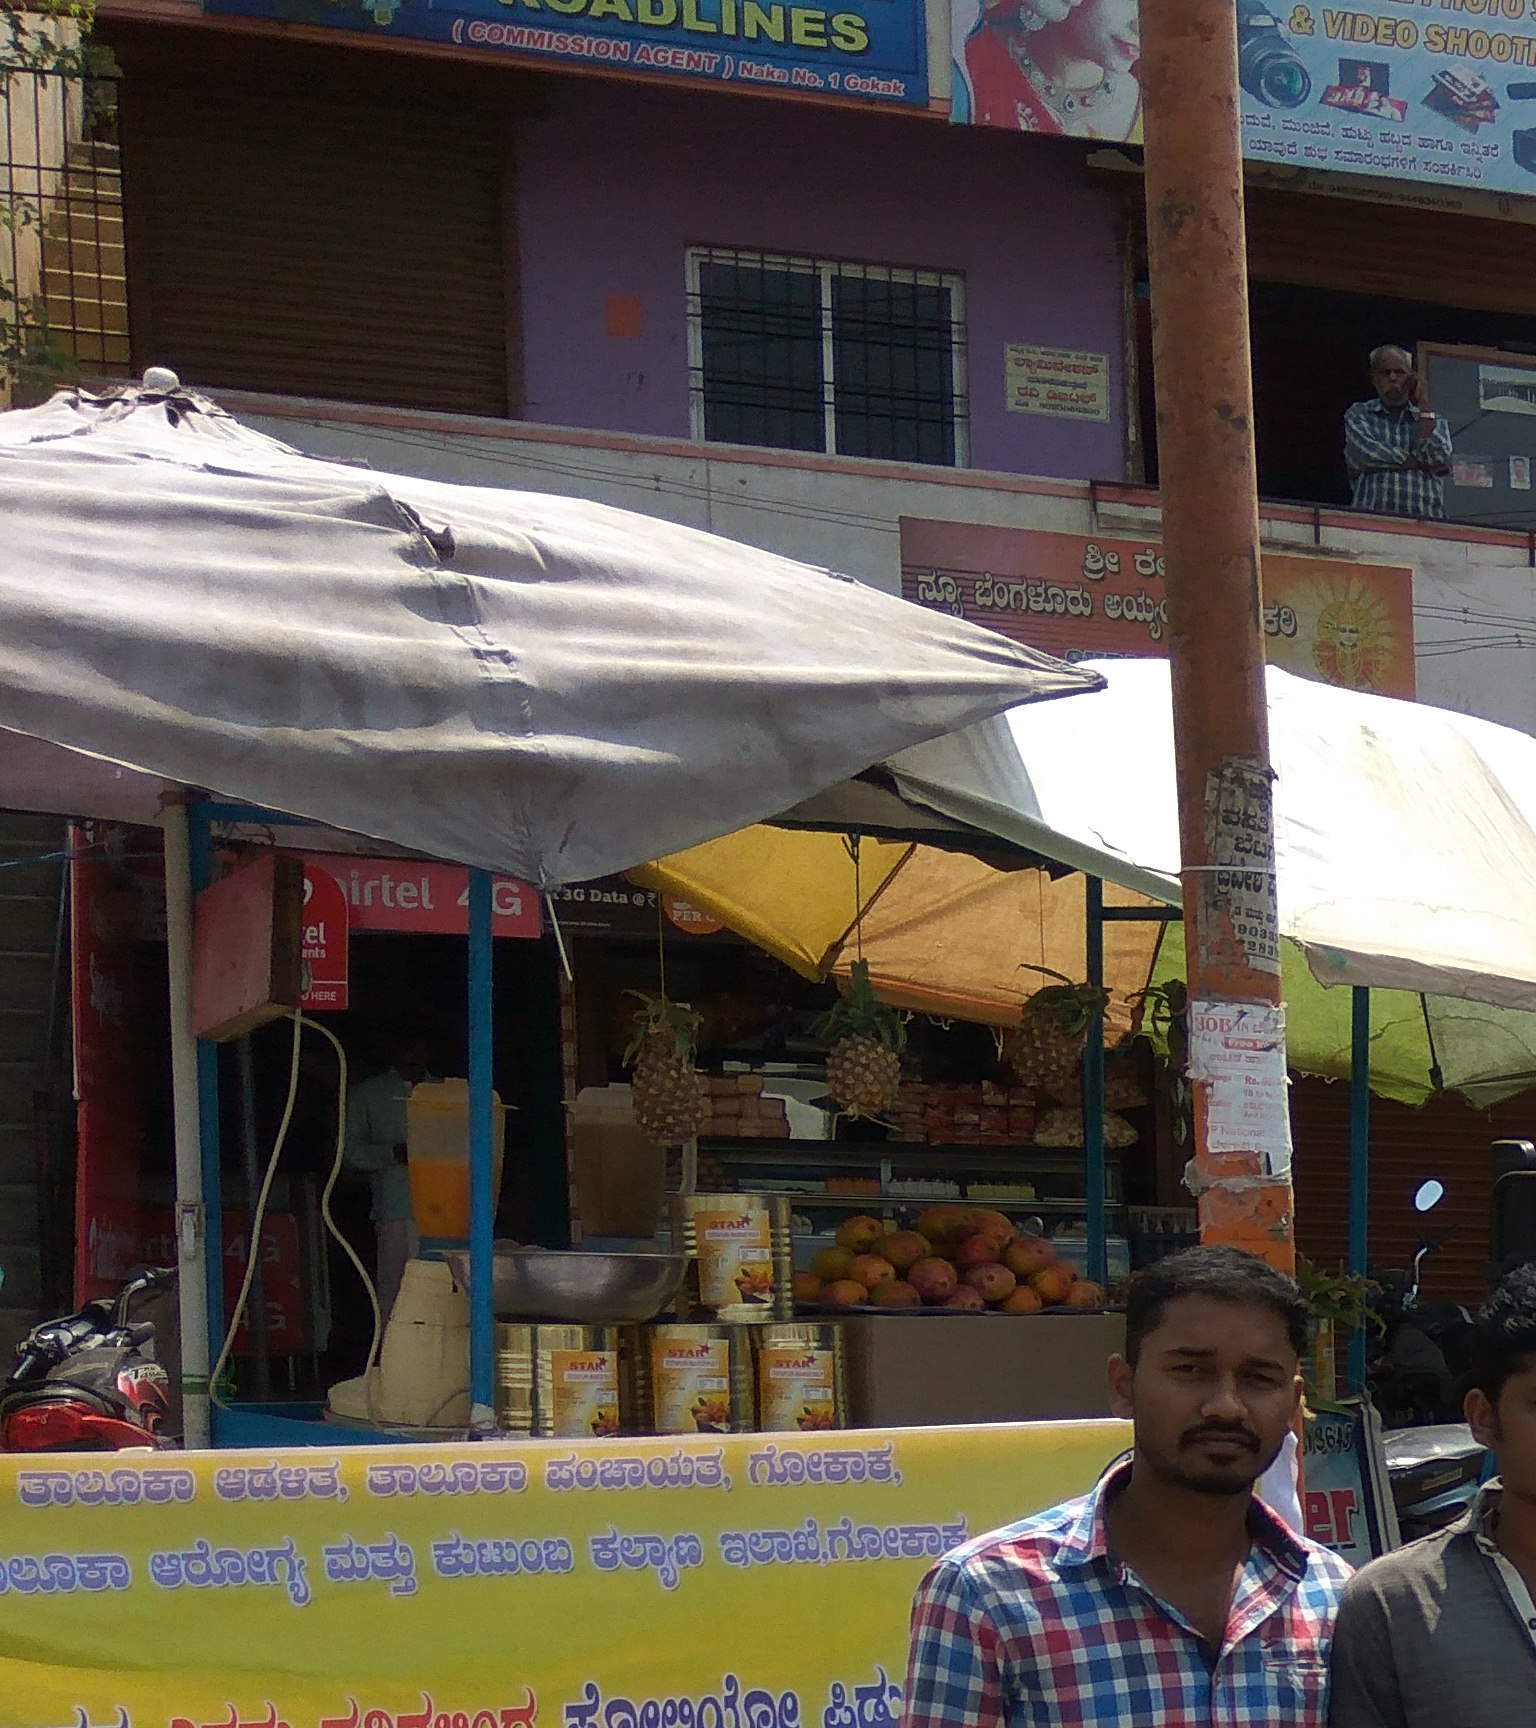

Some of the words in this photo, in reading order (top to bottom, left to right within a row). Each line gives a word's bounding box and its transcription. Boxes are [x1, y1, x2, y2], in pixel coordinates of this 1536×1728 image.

[1288, 4, 1315, 37] &
[1322, 9, 1419, 49] VIDEO
[467, 20, 630, 62] COMMISSION
[635, 43, 718, 74] AGENT
[740, 60, 789, 84] Naka
[792, 67, 826, 88] No.
[844, 73, 907, 98] Gokak
[1083, 543, 1121, 581] ಶ್ರೀ
[974, 572, 1094, 618] ಬೆಂಗಳೂರು
[589, 889, 629, 905] Data
[311, 991, 337, 1001] HERE
[707, 1220, 746, 1230] STAR
[568, 1360, 603, 1371] STAR
[18, 1469, 196, 1505] ತಾಲೂಕಾ
[215, 1460, 350, 1503] ಆಡಳಿತ,
[367, 1460, 527, 1497] ತಾಲೂಕಾ
[149, 1537, 313, 1607] ಆರೋಗ್ಯ
[324, 1532, 419, 1597] ಮತ್ತು
[431, 1530, 575, 1577] ಕುಟುಂಬ
[590, 1524, 704, 1592] ಕಲ್ಯಾಣ
